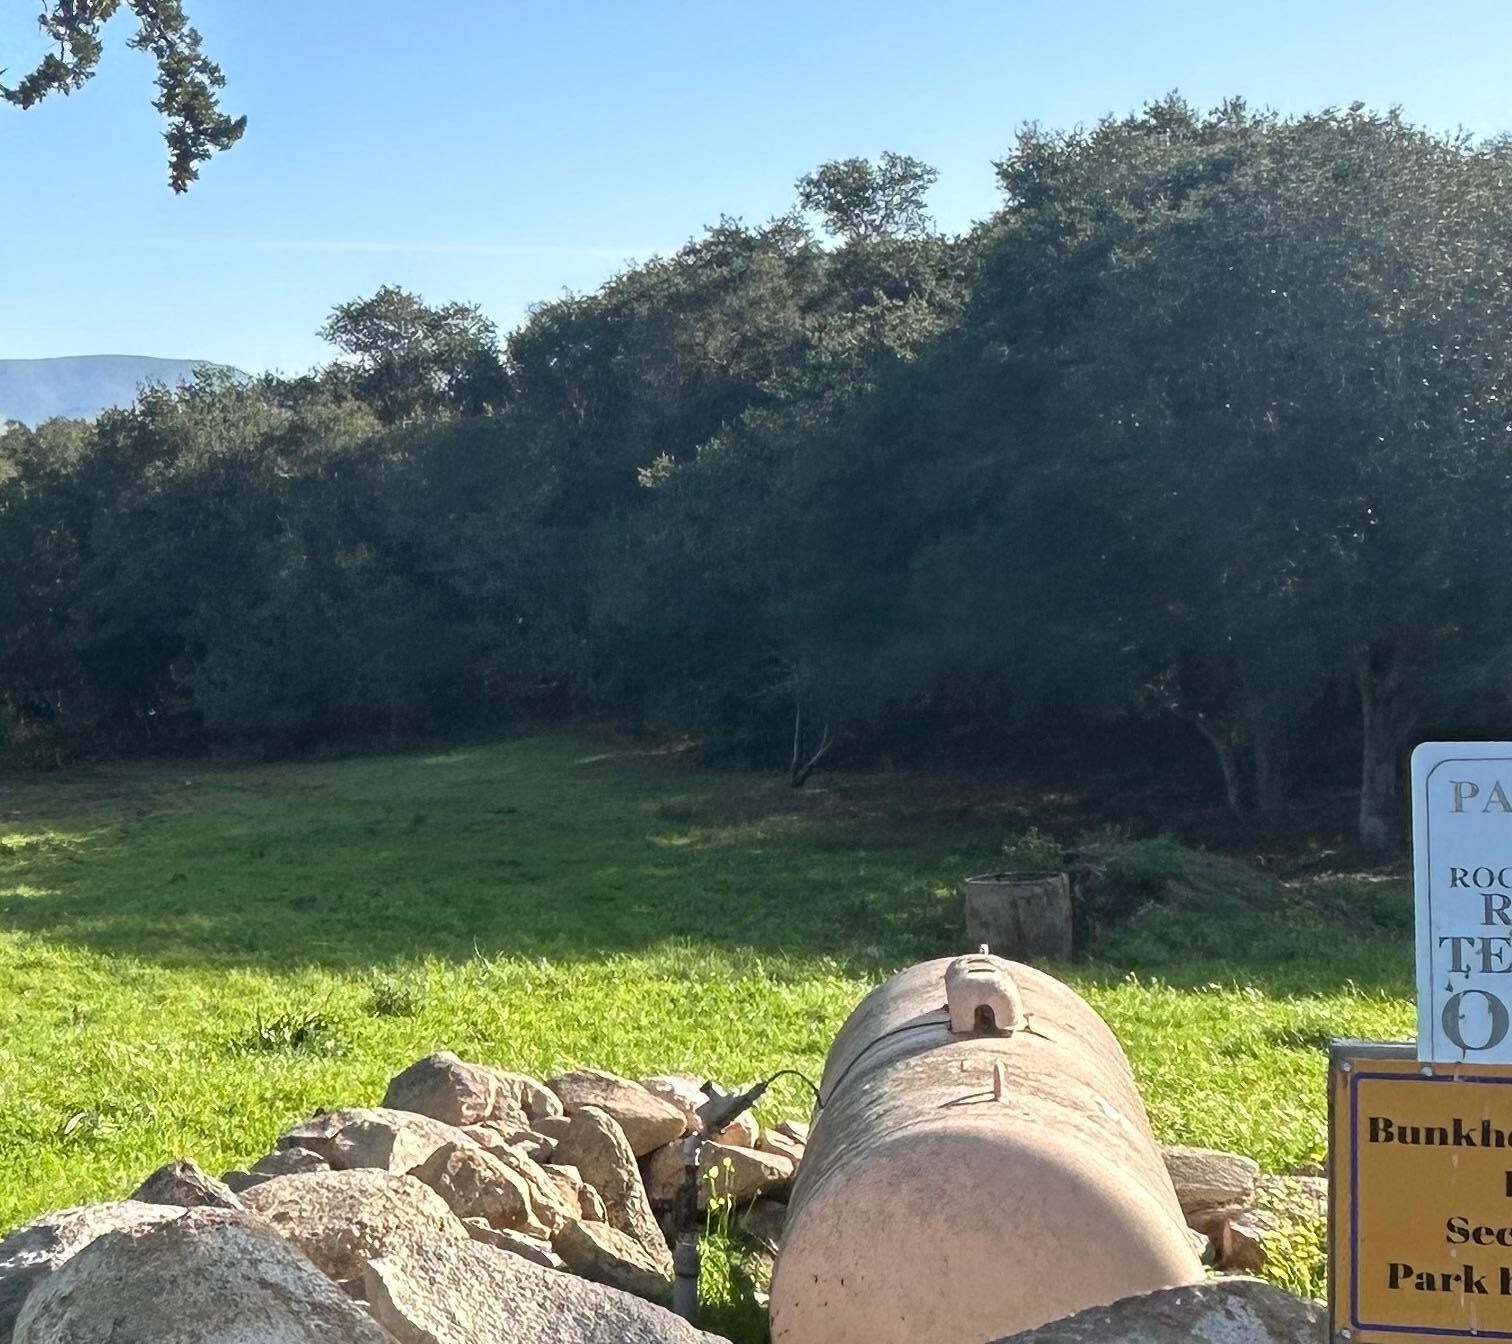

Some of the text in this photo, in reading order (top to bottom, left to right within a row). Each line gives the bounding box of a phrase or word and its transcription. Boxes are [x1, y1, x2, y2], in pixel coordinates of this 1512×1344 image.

[1480, 893, 1512, 926] R
[1439, 936, 1512, 973] TE
[1441, 989, 1510, 1050] O
[1369, 1117, 1512, 1148] Bunkh
[1388, 1263, 1488, 1296] Park
